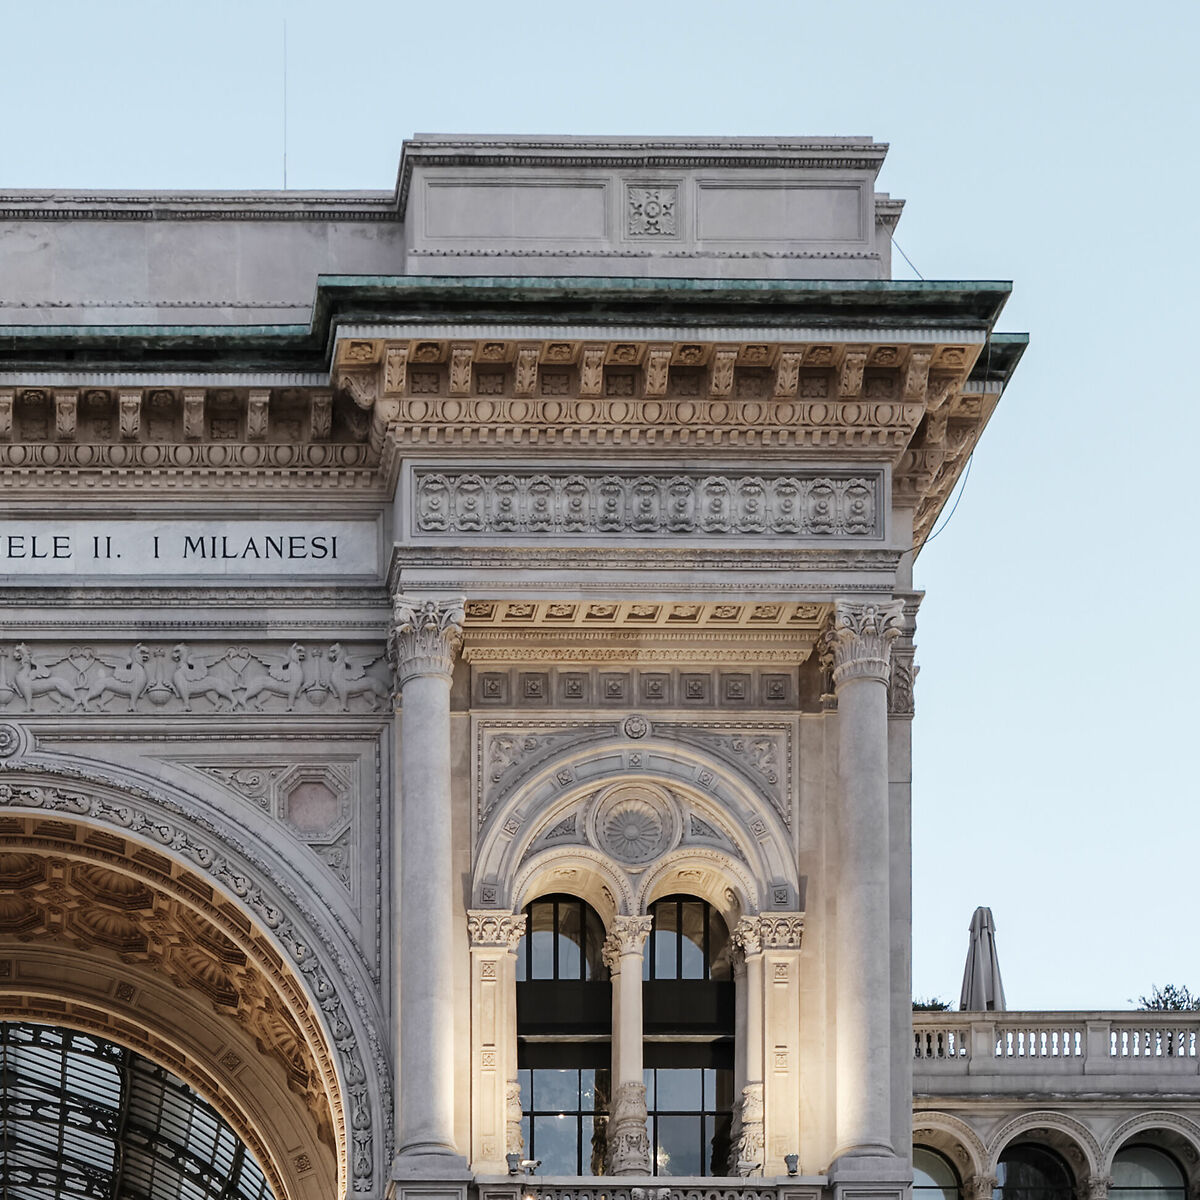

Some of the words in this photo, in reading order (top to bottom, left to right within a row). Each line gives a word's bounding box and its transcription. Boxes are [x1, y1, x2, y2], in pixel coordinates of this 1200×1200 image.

[93, 535, 122, 559] II.
[152, 535, 160, 559] I
[183, 535, 338, 559] MILANESI
